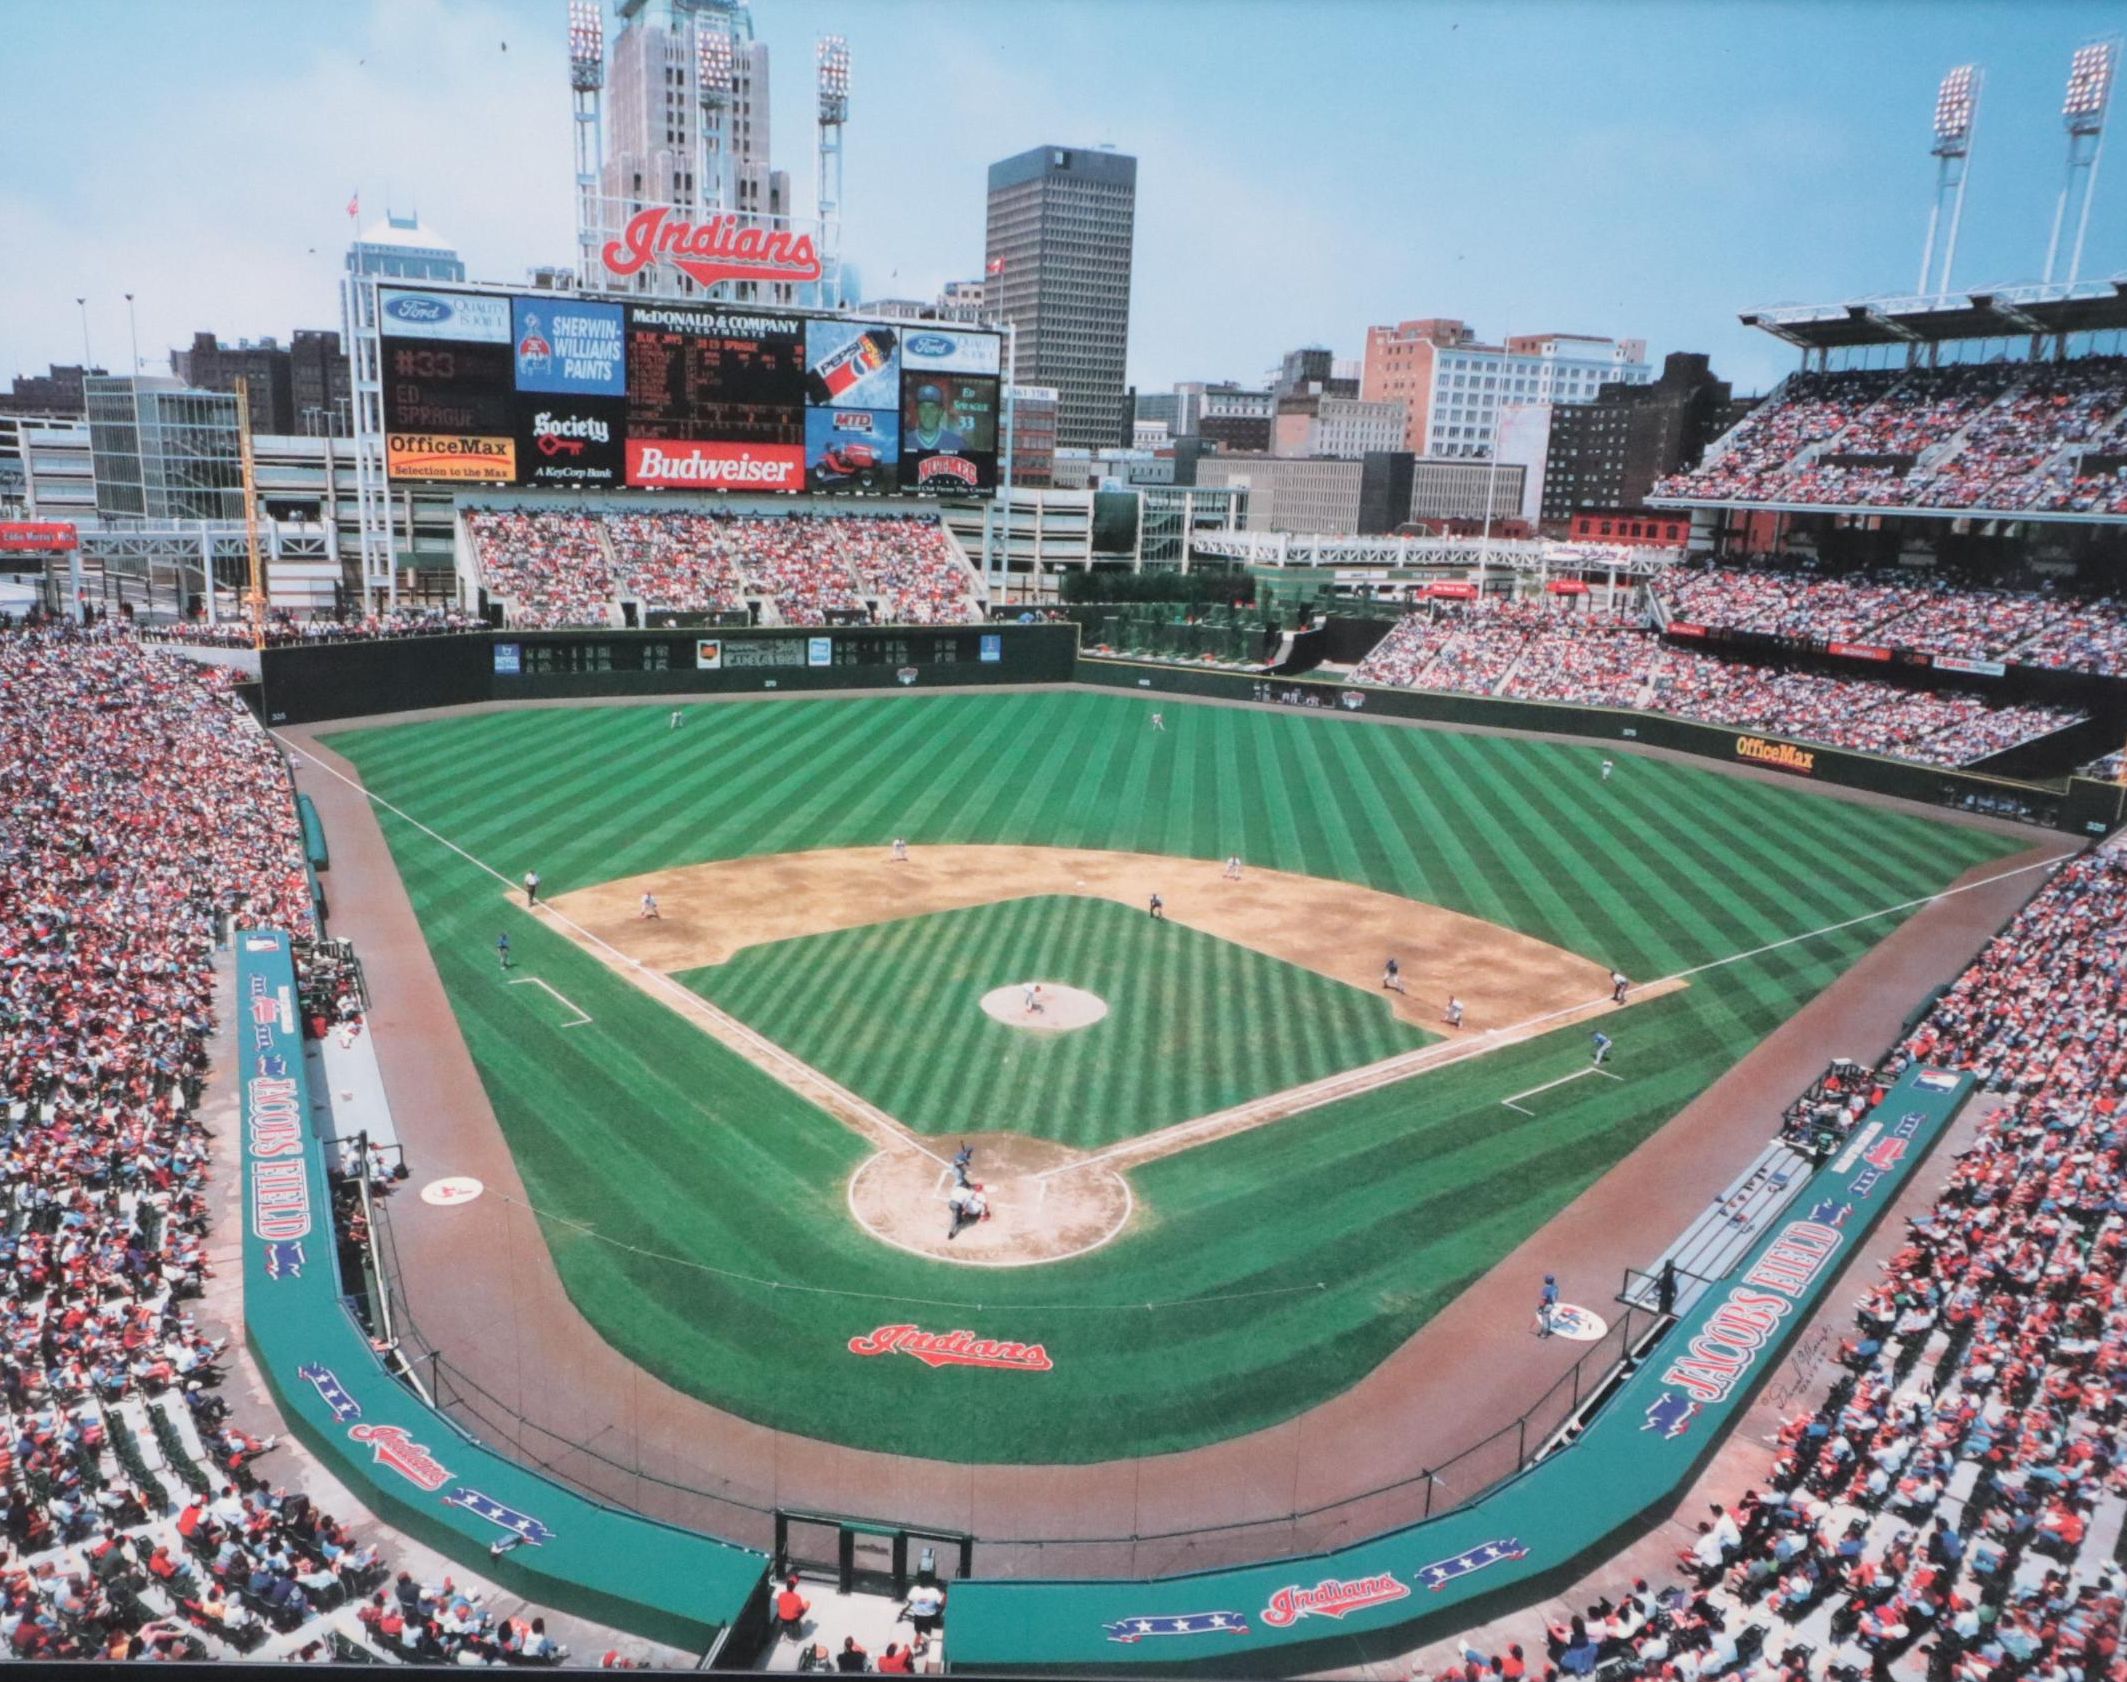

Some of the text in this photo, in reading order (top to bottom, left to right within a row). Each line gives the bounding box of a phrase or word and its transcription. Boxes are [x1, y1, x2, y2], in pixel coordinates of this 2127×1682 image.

[602, 207, 822, 288] Indians
[398, 299, 440, 319] Ford
[552, 316, 621, 339] SHERWIN-
[633, 309, 798, 334] McDONALD & COMPANY
[668, 325, 766, 338] INVESTMENTS
[553, 338, 621, 361] WILLIAMS
[914, 337, 948, 354] Ford
[396, 350, 455, 378] #33
[563, 359, 612, 381] PAINTS
[820, 341, 861, 375] PEPSI
[396, 385, 419, 403] ED
[533, 411, 610, 443] Society
[836, 414, 870, 426] MTD
[959, 416, 975, 430] 33
[390, 436, 507, 456] OfficeMax
[395, 465, 508, 478] Selection to the Max
[535, 467, 612, 479] A KeyCorp Bank
[636, 448, 794, 482] Budweiser
[1735, 735, 1815, 769] OfficeMax
[247, 1078, 312, 1241] JACOBS FIELD
[1662, 1288, 1793, 1403] JACOBS
[1743, 1220, 1844, 1297] FIELD
[847, 1324, 1054, 1372] Indians
[348, 1423, 458, 1491] Indians
[1260, 1572, 1412, 1628] Indians
